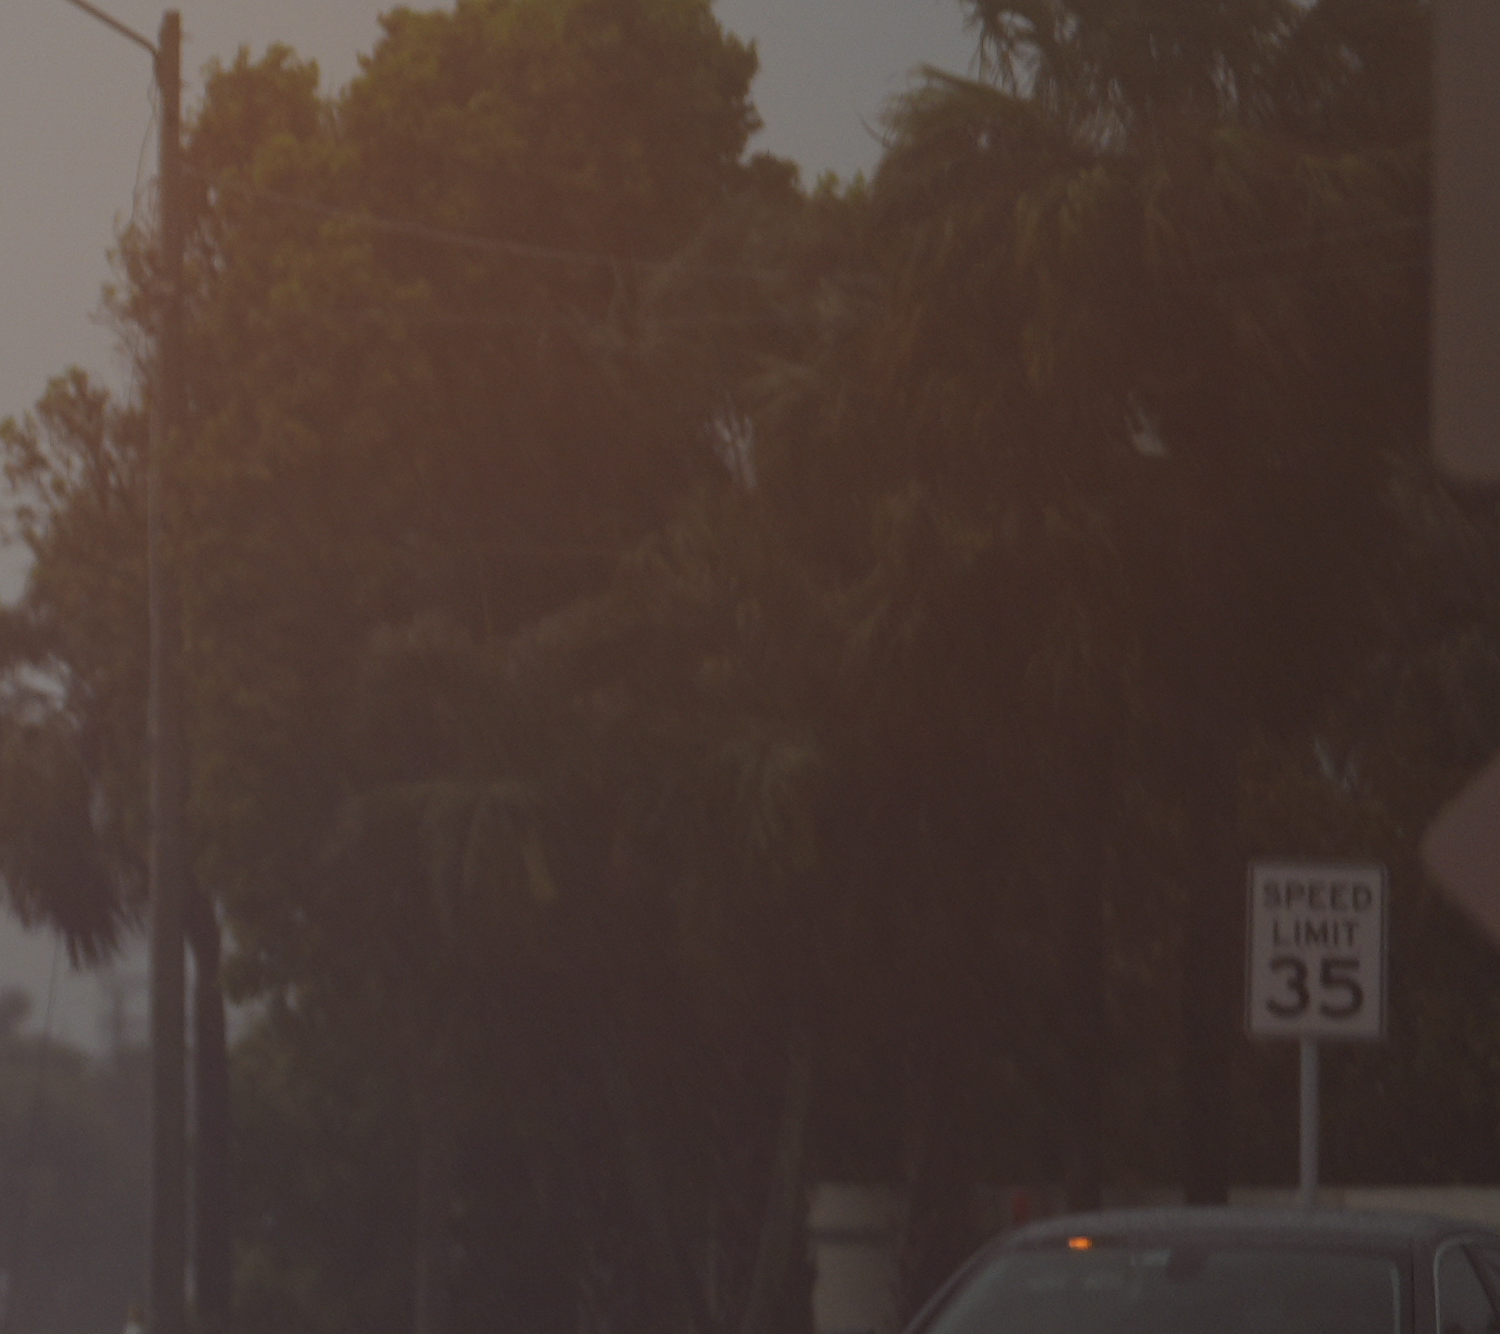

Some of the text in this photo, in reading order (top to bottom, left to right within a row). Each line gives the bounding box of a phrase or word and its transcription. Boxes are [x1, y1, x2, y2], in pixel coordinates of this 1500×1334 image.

[1263, 879, 1372, 911] SPEED
[1272, 919, 1359, 947] LIMIT
[1266, 955, 1364, 1017] 35
